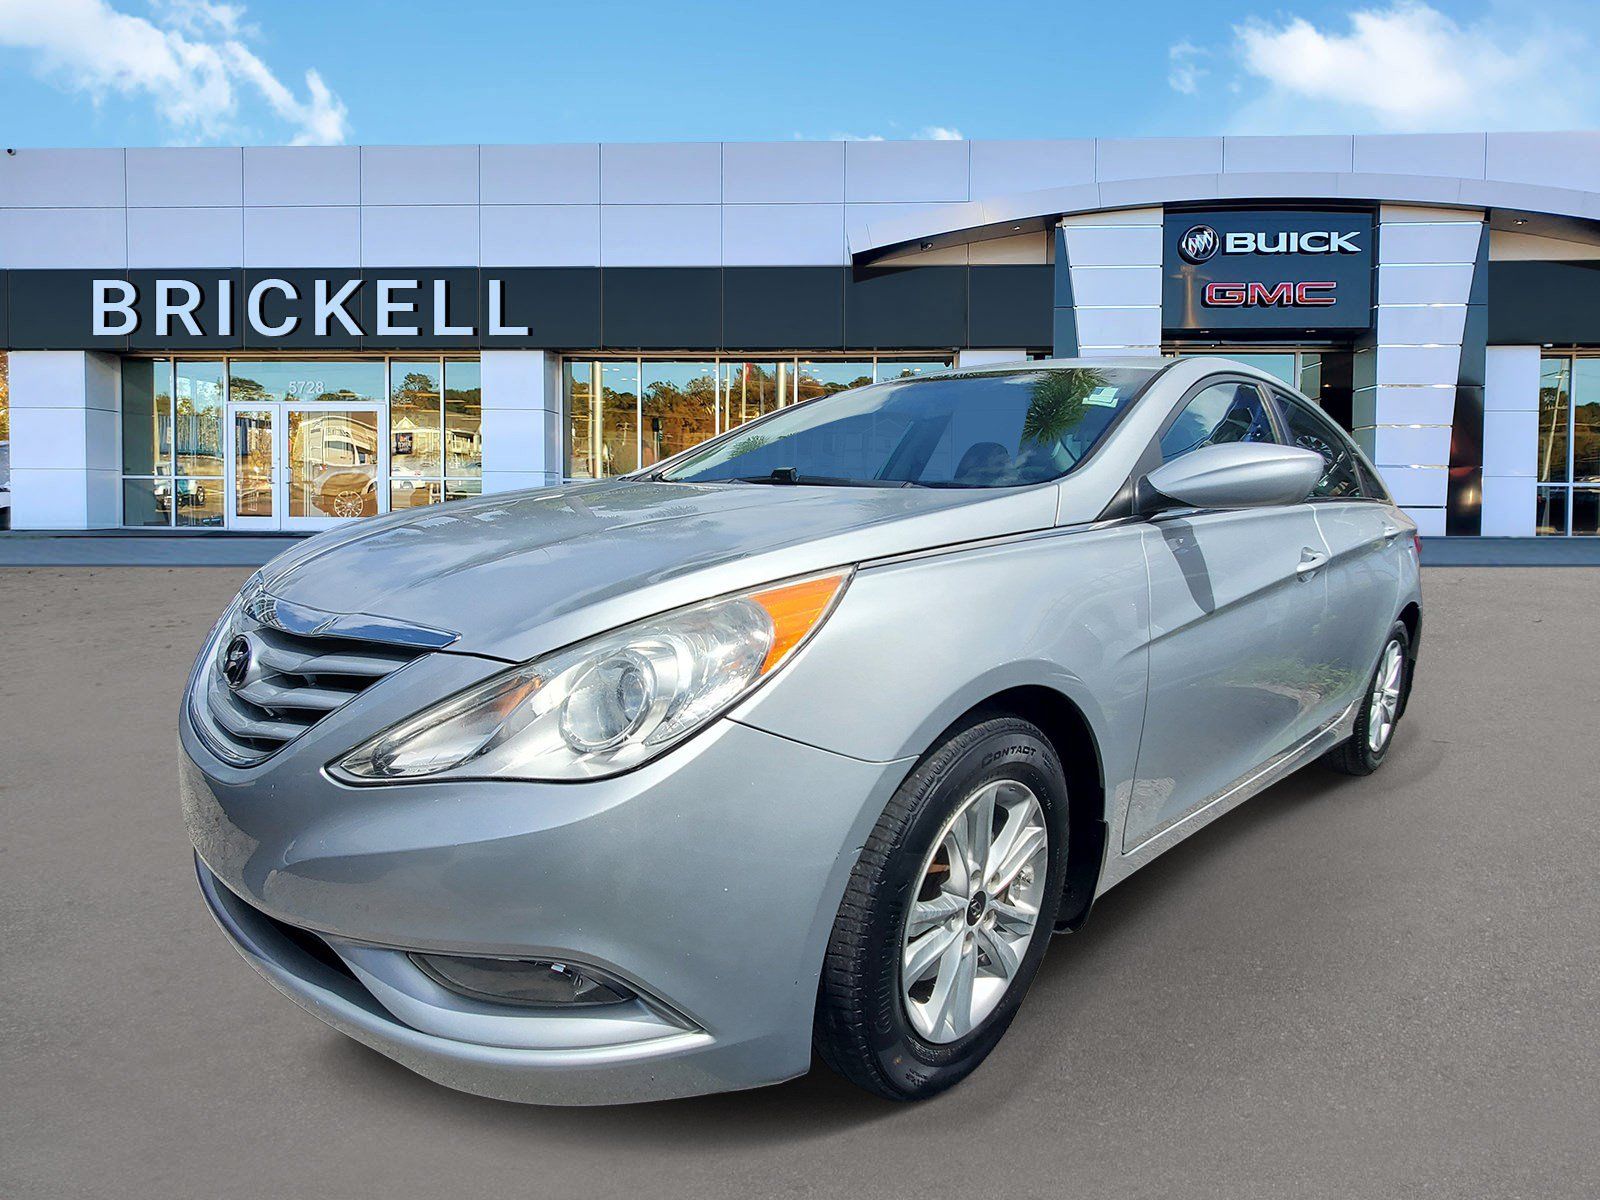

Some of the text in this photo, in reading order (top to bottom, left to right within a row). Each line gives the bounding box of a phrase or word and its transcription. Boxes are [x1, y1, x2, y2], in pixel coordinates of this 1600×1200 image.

[1225, 231, 1362, 253] BUICK
[1205, 281, 1337, 305] GMC
[91, 278, 530, 337] BRICKELL
[288, 380, 325, 394] 5728
[981, 745, 1037, 769] CONTACT
